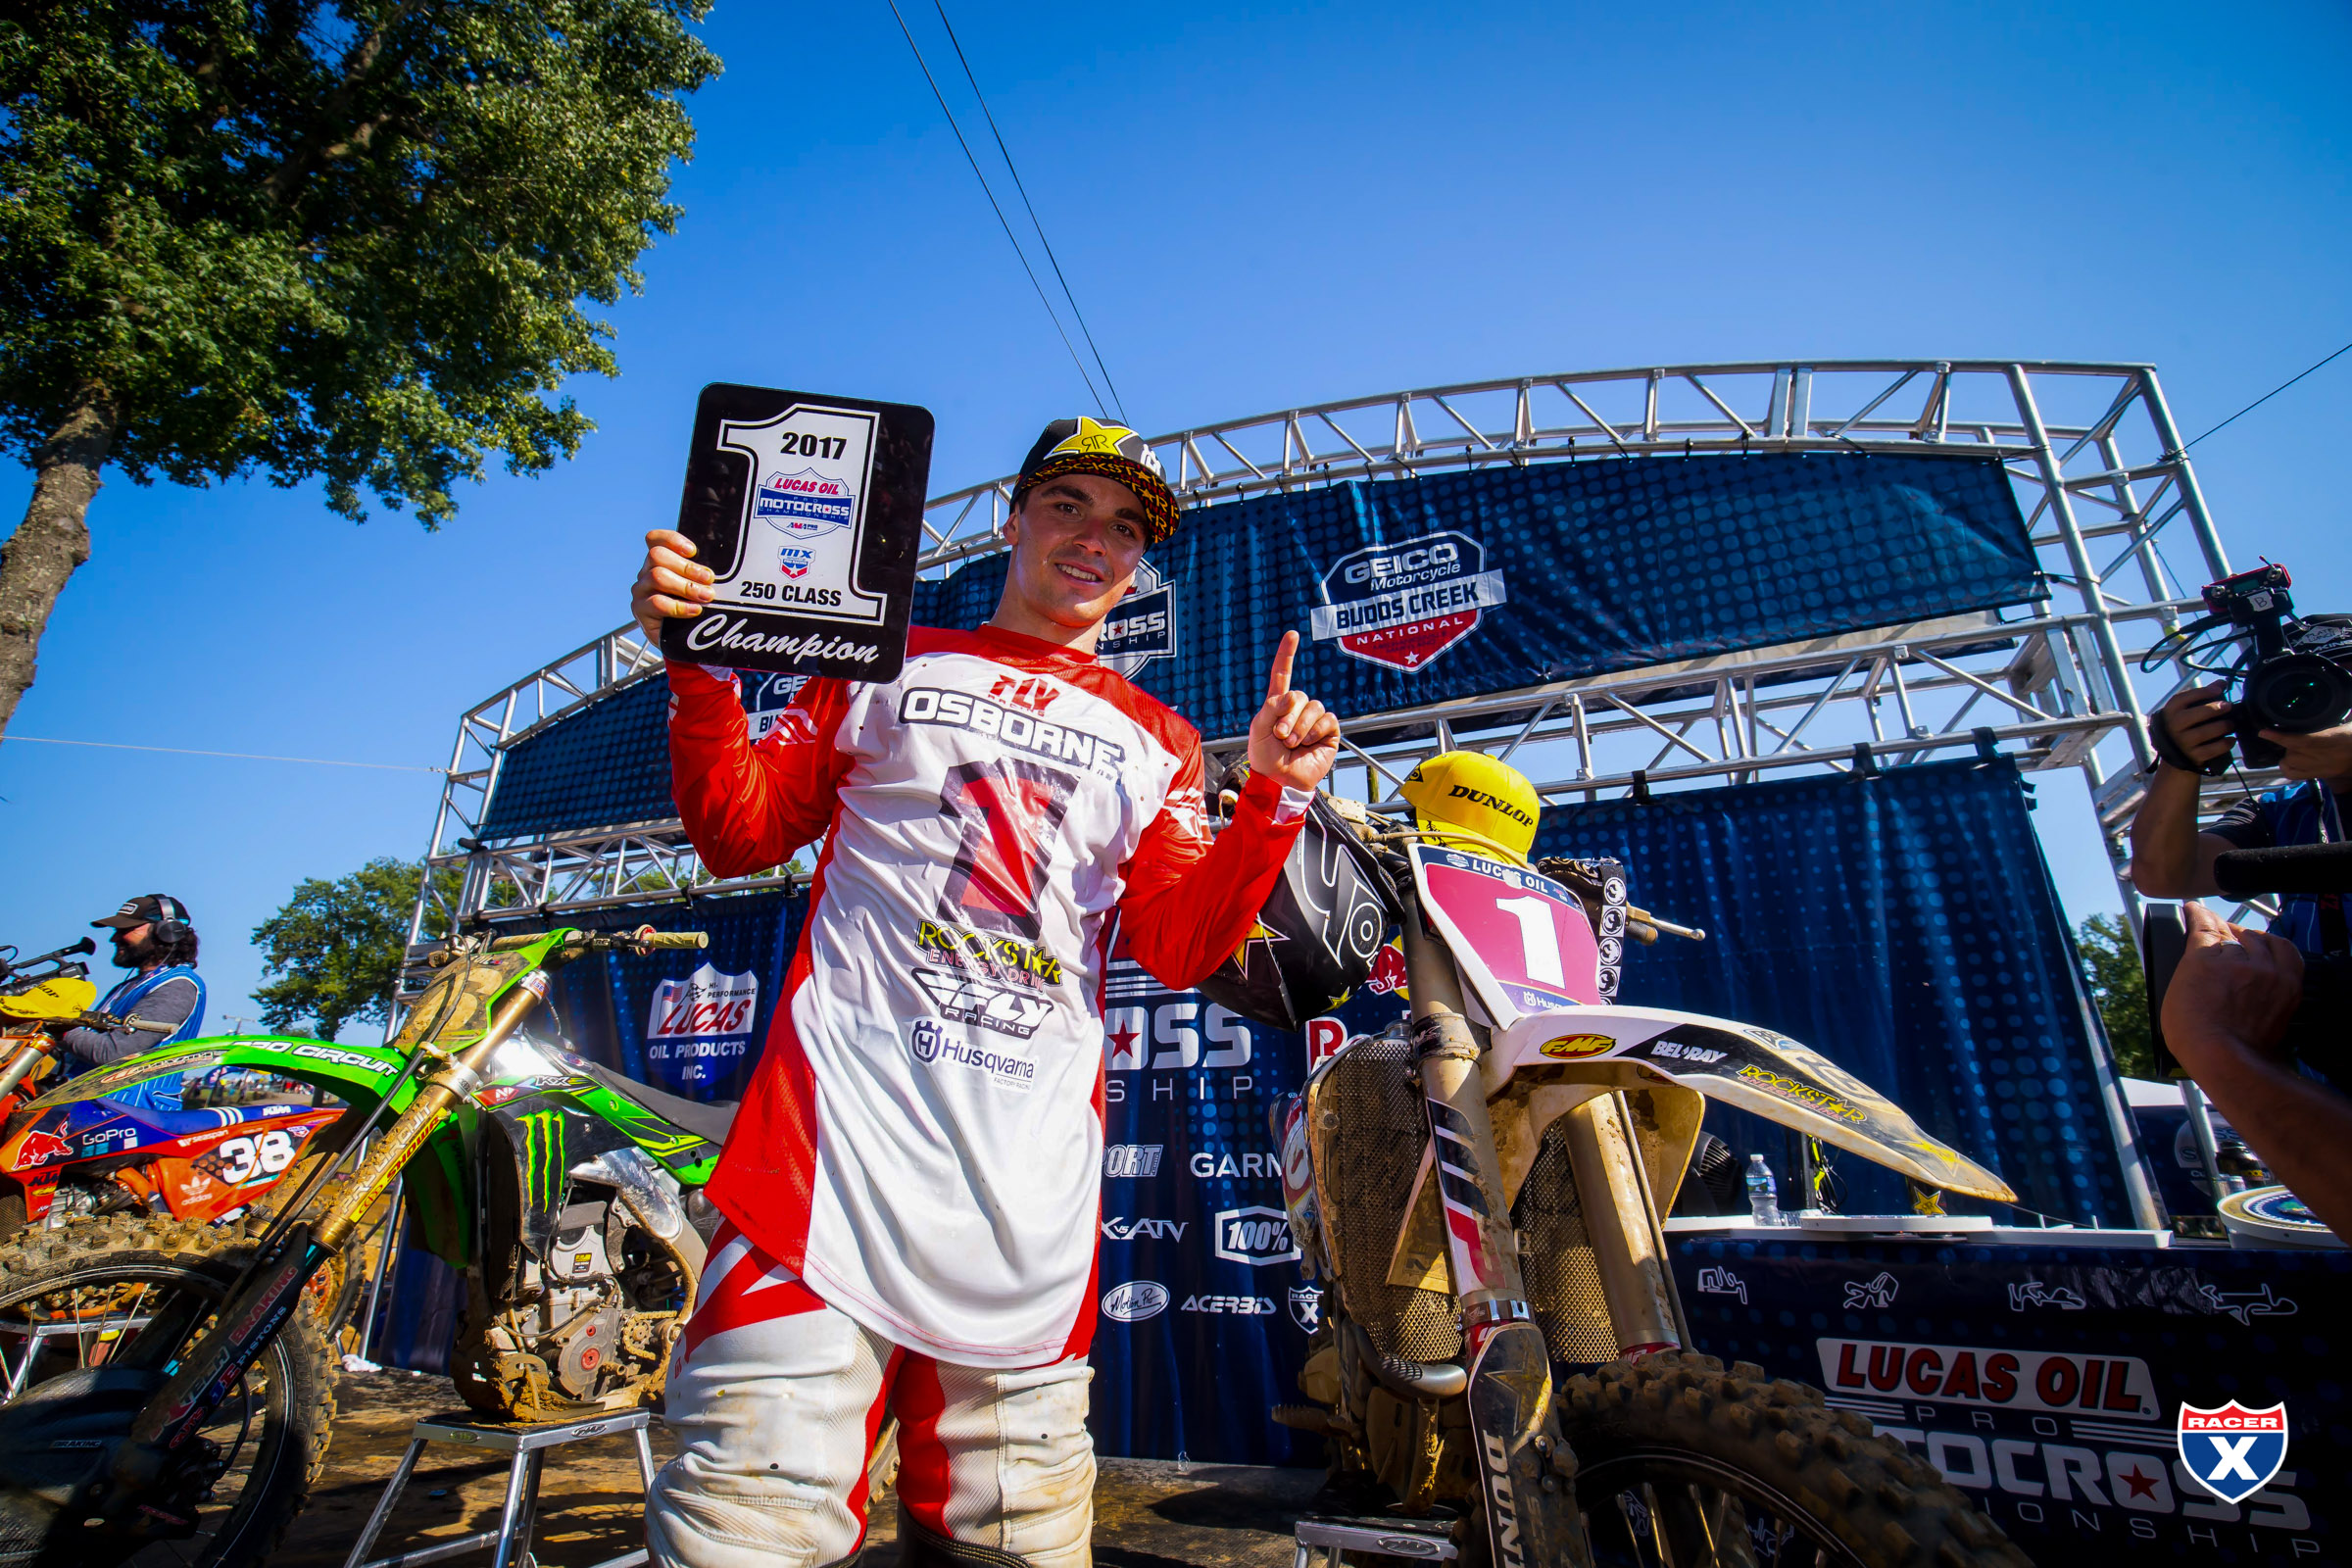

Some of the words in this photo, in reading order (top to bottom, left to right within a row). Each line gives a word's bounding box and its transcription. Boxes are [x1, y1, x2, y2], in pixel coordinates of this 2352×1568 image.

[780, 431, 847, 461] 2017
[774, 478, 817, 492] LUCAS
[818, 482, 840, 495] OIL
[759, 498, 850, 516] MOTOCROSS
[759, 508, 850, 520] CHAMPIONSHIP
[1344, 542, 1458, 584] GEICO
[1370, 562, 1461, 591] Motorcycle
[740, 581, 775, 600] 250
[781, 585, 842, 607] CLASS
[1337, 597, 1405, 629] BUDDS
[1408, 581, 1480, 614] CREEK
[2255, 596, 2268, 608] B
[686, 613, 879, 664] Champion
[1356, 617, 1464, 646] NATIONAL
[987, 694, 1046, 717] RACING
[989, 674, 1060, 711] FLY
[899, 687, 1126, 775] OSBORNE
[1447, 784, 1534, 828] DUNLOP
[1525, 875, 1548, 894] OIL
[1495, 896, 1566, 990] 1
[930, 948, 1002, 979] ENERGY
[1006, 968, 1047, 993] DRINK
[707, 988, 756, 999] PERFORMANCE
[913, 968, 1054, 1027] FLY
[657, 999, 752, 1036] LUCAS
[944, 1007, 1030, 1035] RACING
[293, 1044, 400, 1077] CIRCUIT
[649, 1045, 670, 1059] OIL
[675, 1041, 746, 1058] PRODUCTS
[942, 1037, 1035, 1079] Husqvarna
[1540, 1037, 1615, 1054] FMF
[535, 1076, 571, 1087] KX
[681, 1065, 707, 1081] INC.
[263, 1105, 291, 1116] KTM
[1741, 1076, 1797, 1100] ENERGY
[1798, 1099, 1843, 1120] DRINK
[82, 1127, 137, 1146] GoPro
[386, 1116, 441, 1180] SHOWA
[219, 1131, 296, 1184] 38
[181, 1193, 214, 1205] adidas
[1121, 1218, 1190, 1244] ATV
[1227, 1221, 1290, 1251] 100%
[228, 1263, 298, 1347] BRAKING
[1299, 1302, 1319, 1324] X
[238, 1305, 287, 1366] PISTONS
[1837, 1343, 2020, 1403] LUCAS
[2035, 1354, 2143, 1413] OIL
[1917, 1404, 2059, 1436] PRO
